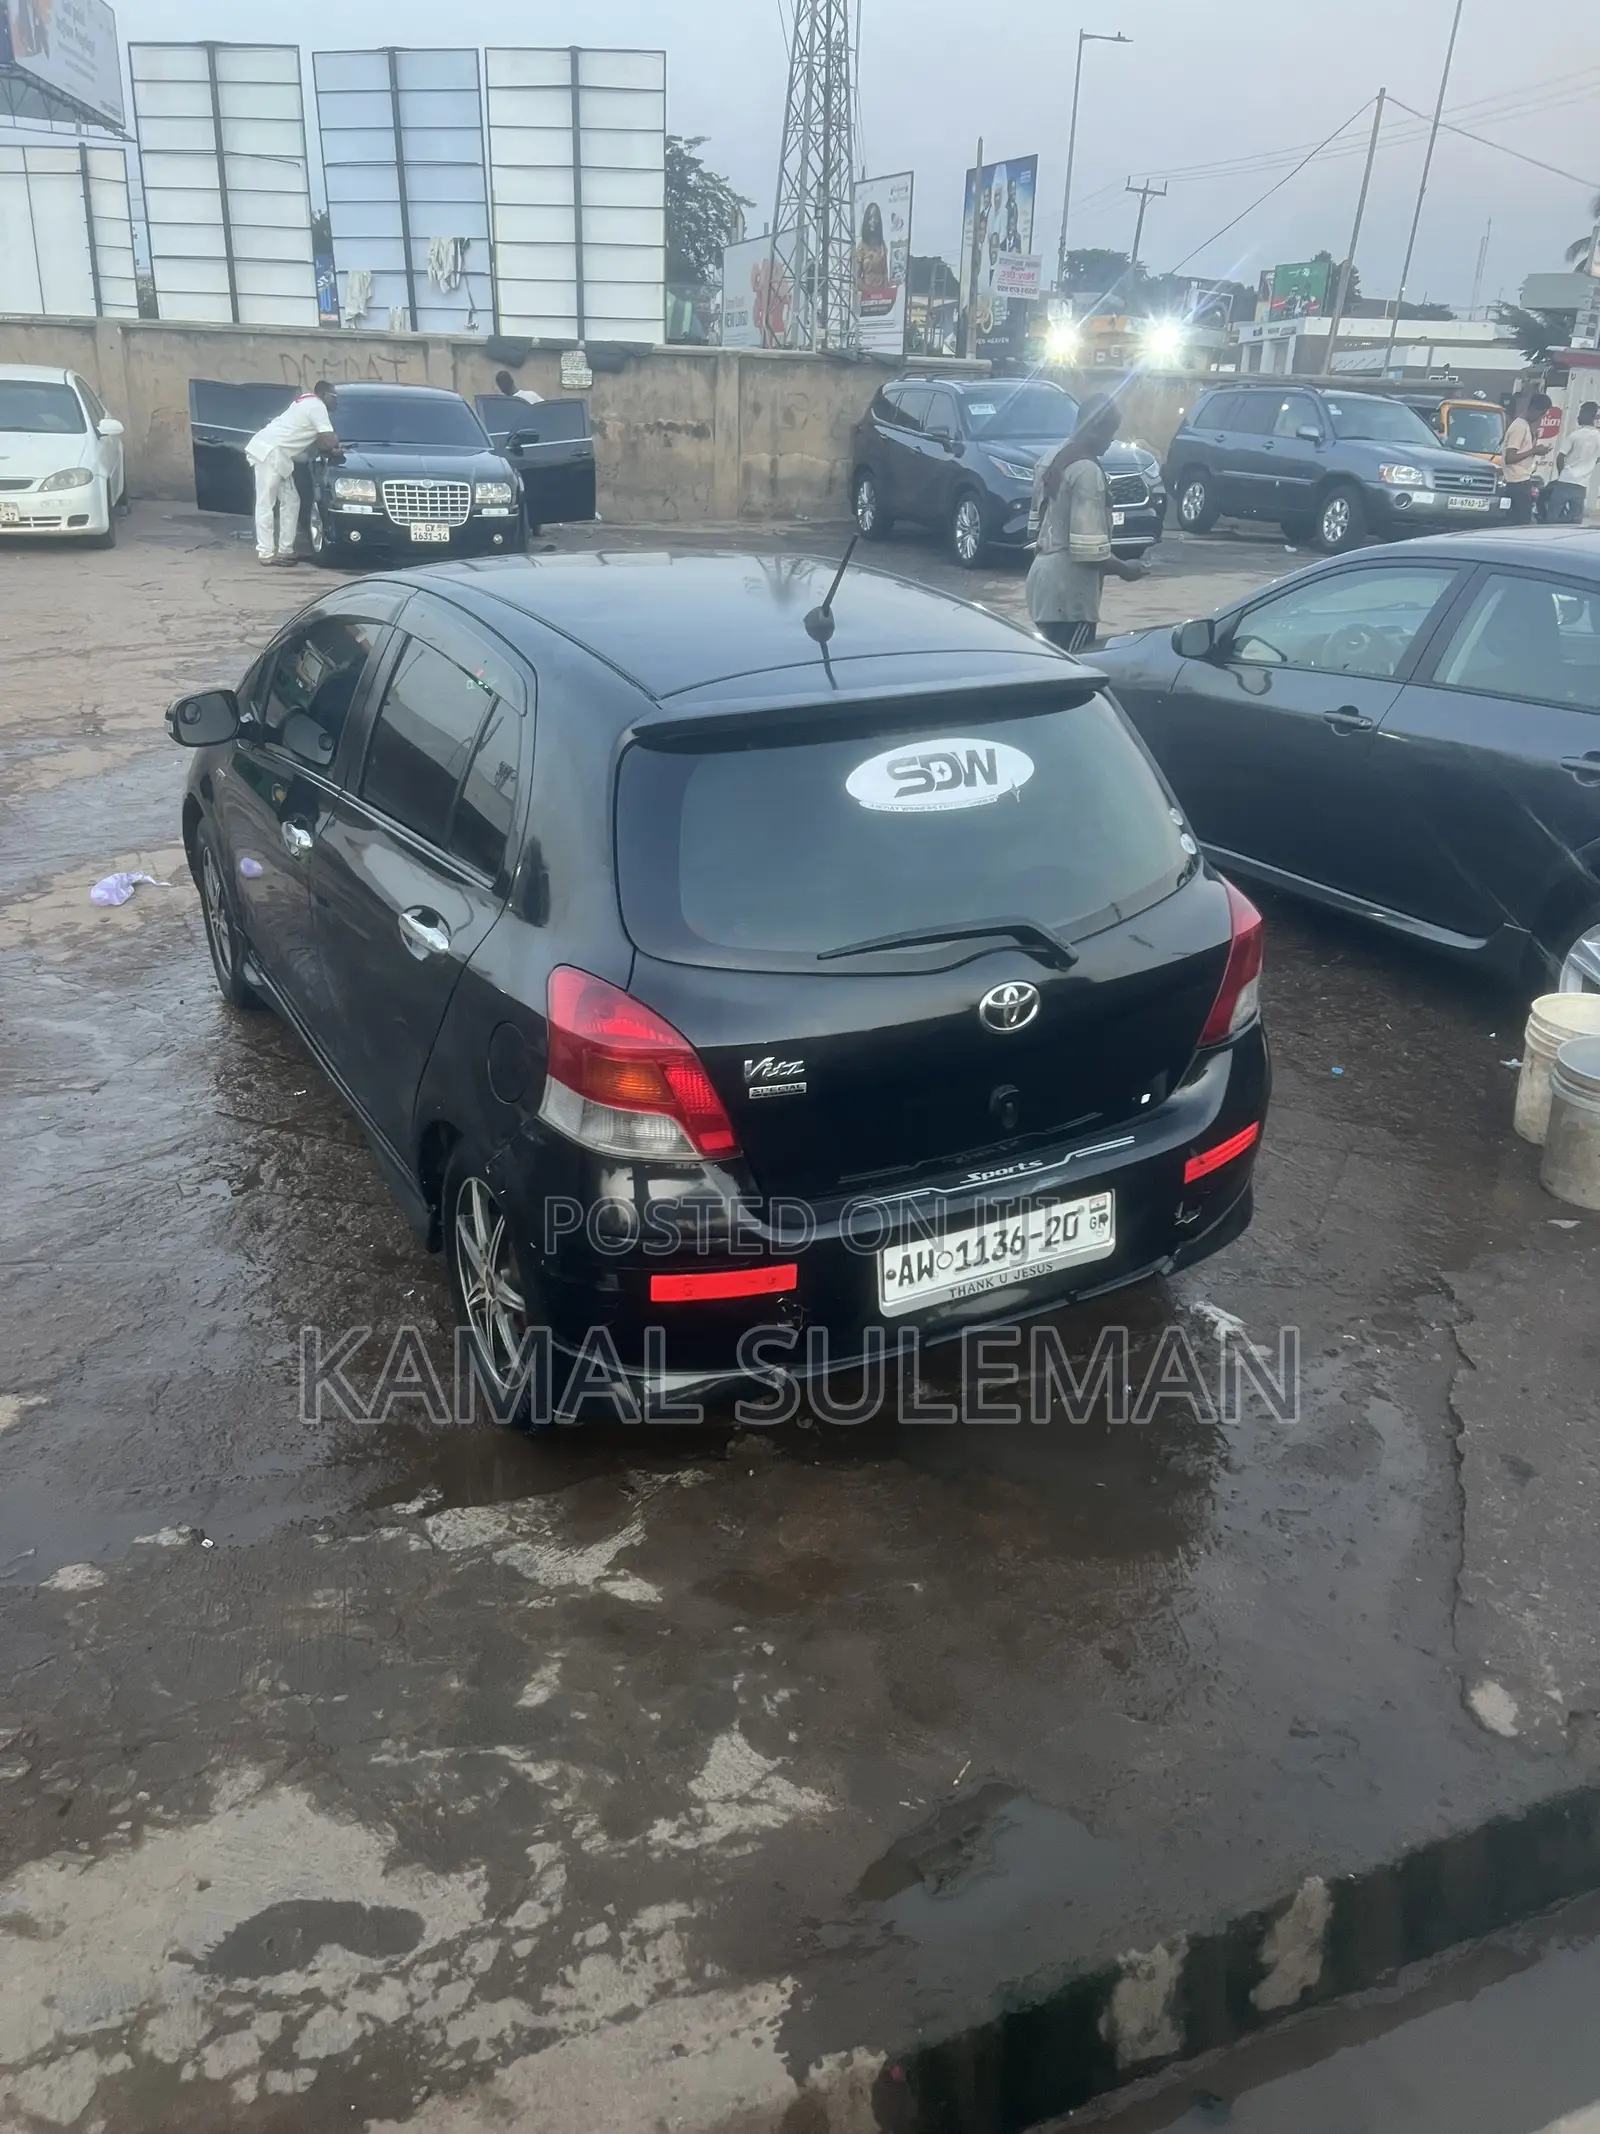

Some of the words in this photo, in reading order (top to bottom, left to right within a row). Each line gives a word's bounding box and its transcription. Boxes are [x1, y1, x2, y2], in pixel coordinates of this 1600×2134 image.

[413, 532, 448, 541] 1631-14
[960, 1159, 1043, 1184] Sports
[898, 1249, 935, 1287] AW
[955, 1209, 1080, 1272] 1136-20
[948, 1277, 994, 1298] THANK
[1000, 1271, 1008, 1284] U
[1014, 1261, 1053, 1280] JESUS
